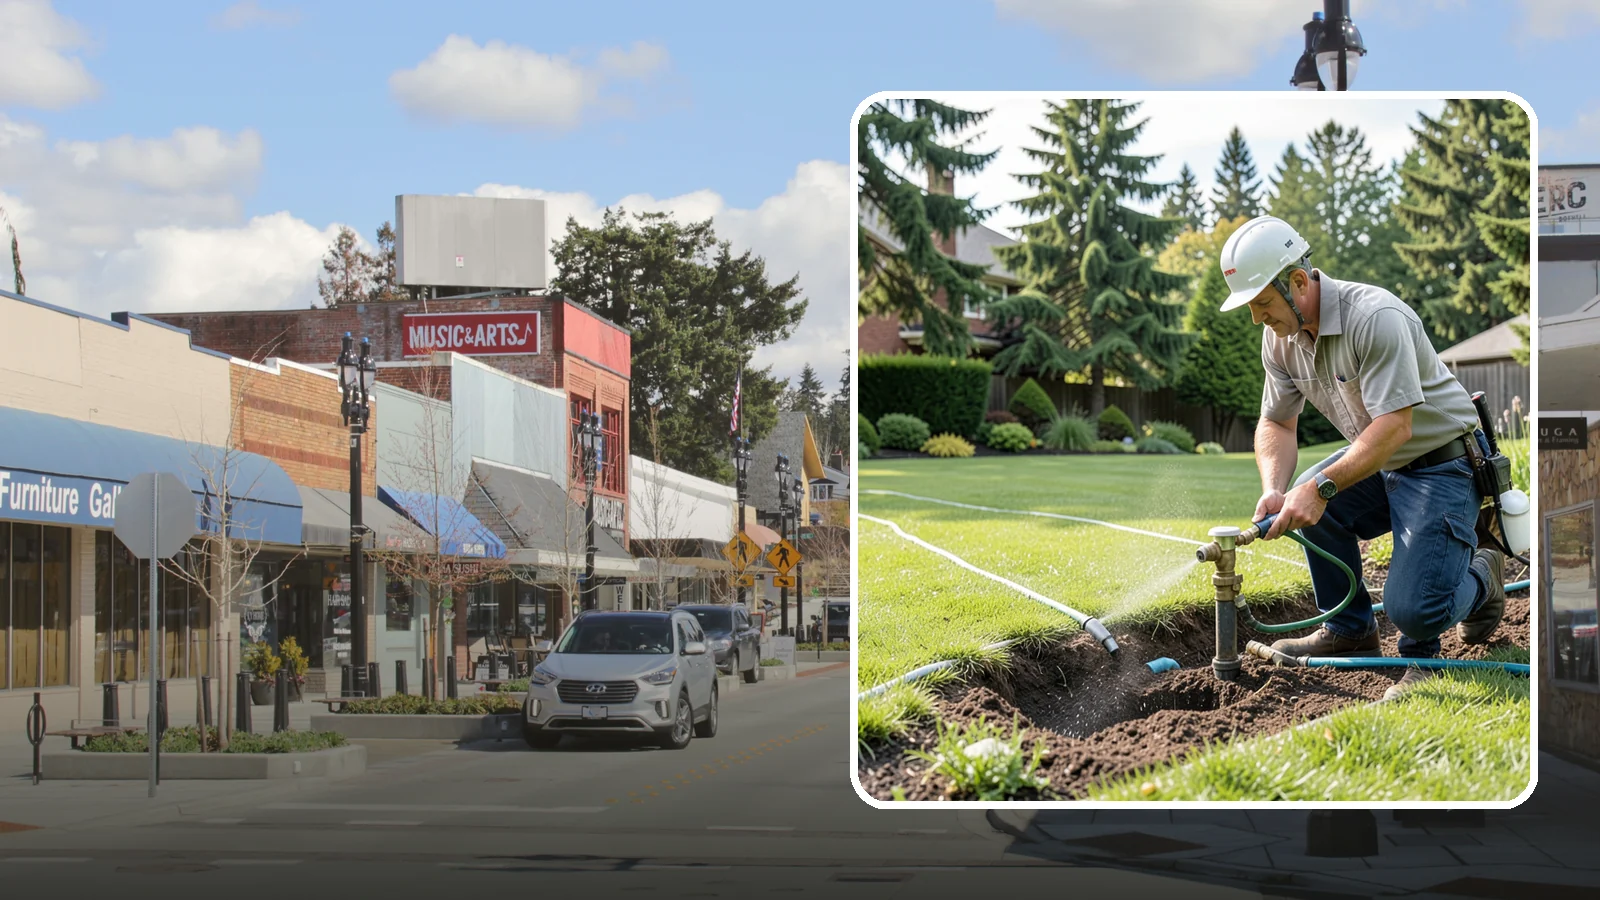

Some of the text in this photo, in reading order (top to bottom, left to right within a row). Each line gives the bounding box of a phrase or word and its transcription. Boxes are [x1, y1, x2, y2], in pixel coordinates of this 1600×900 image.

[1540, 428, 1577, 437] UGA
[0, 471, 122, 519] Furniture Gal
[453, 563, 479, 574] SUSHI
